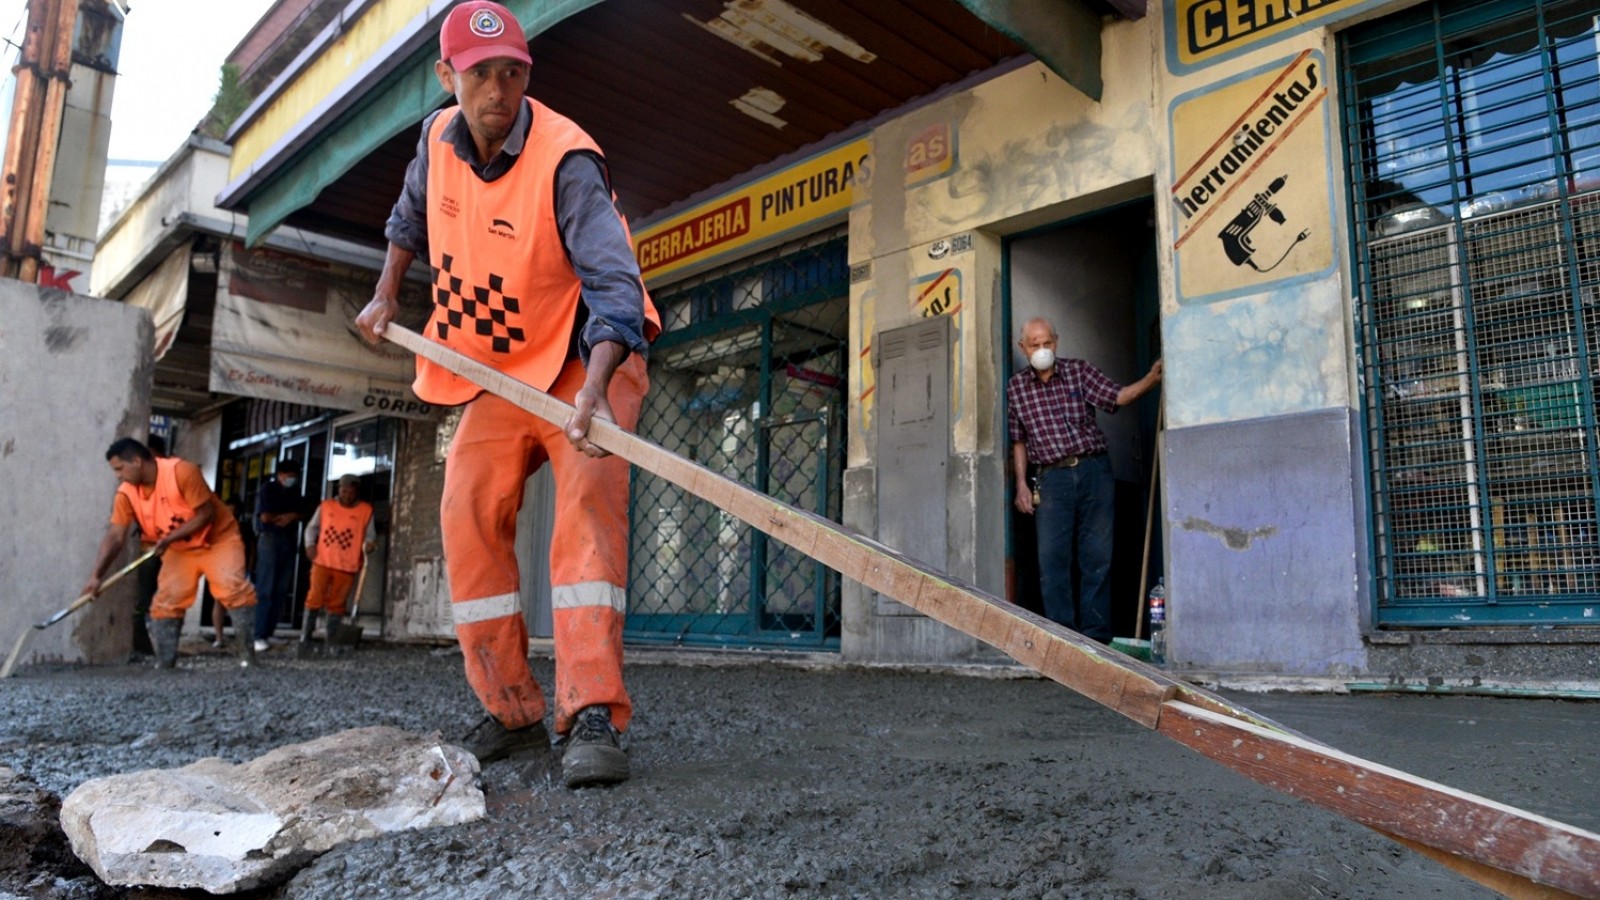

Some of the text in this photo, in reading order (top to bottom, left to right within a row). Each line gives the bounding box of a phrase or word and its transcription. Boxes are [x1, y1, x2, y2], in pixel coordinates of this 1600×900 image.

[1172, 63, 1318, 219] herramientas
[640, 154, 872, 269] CERRAJERIA PINTURAS
[363, 395, 431, 415] CORPO
